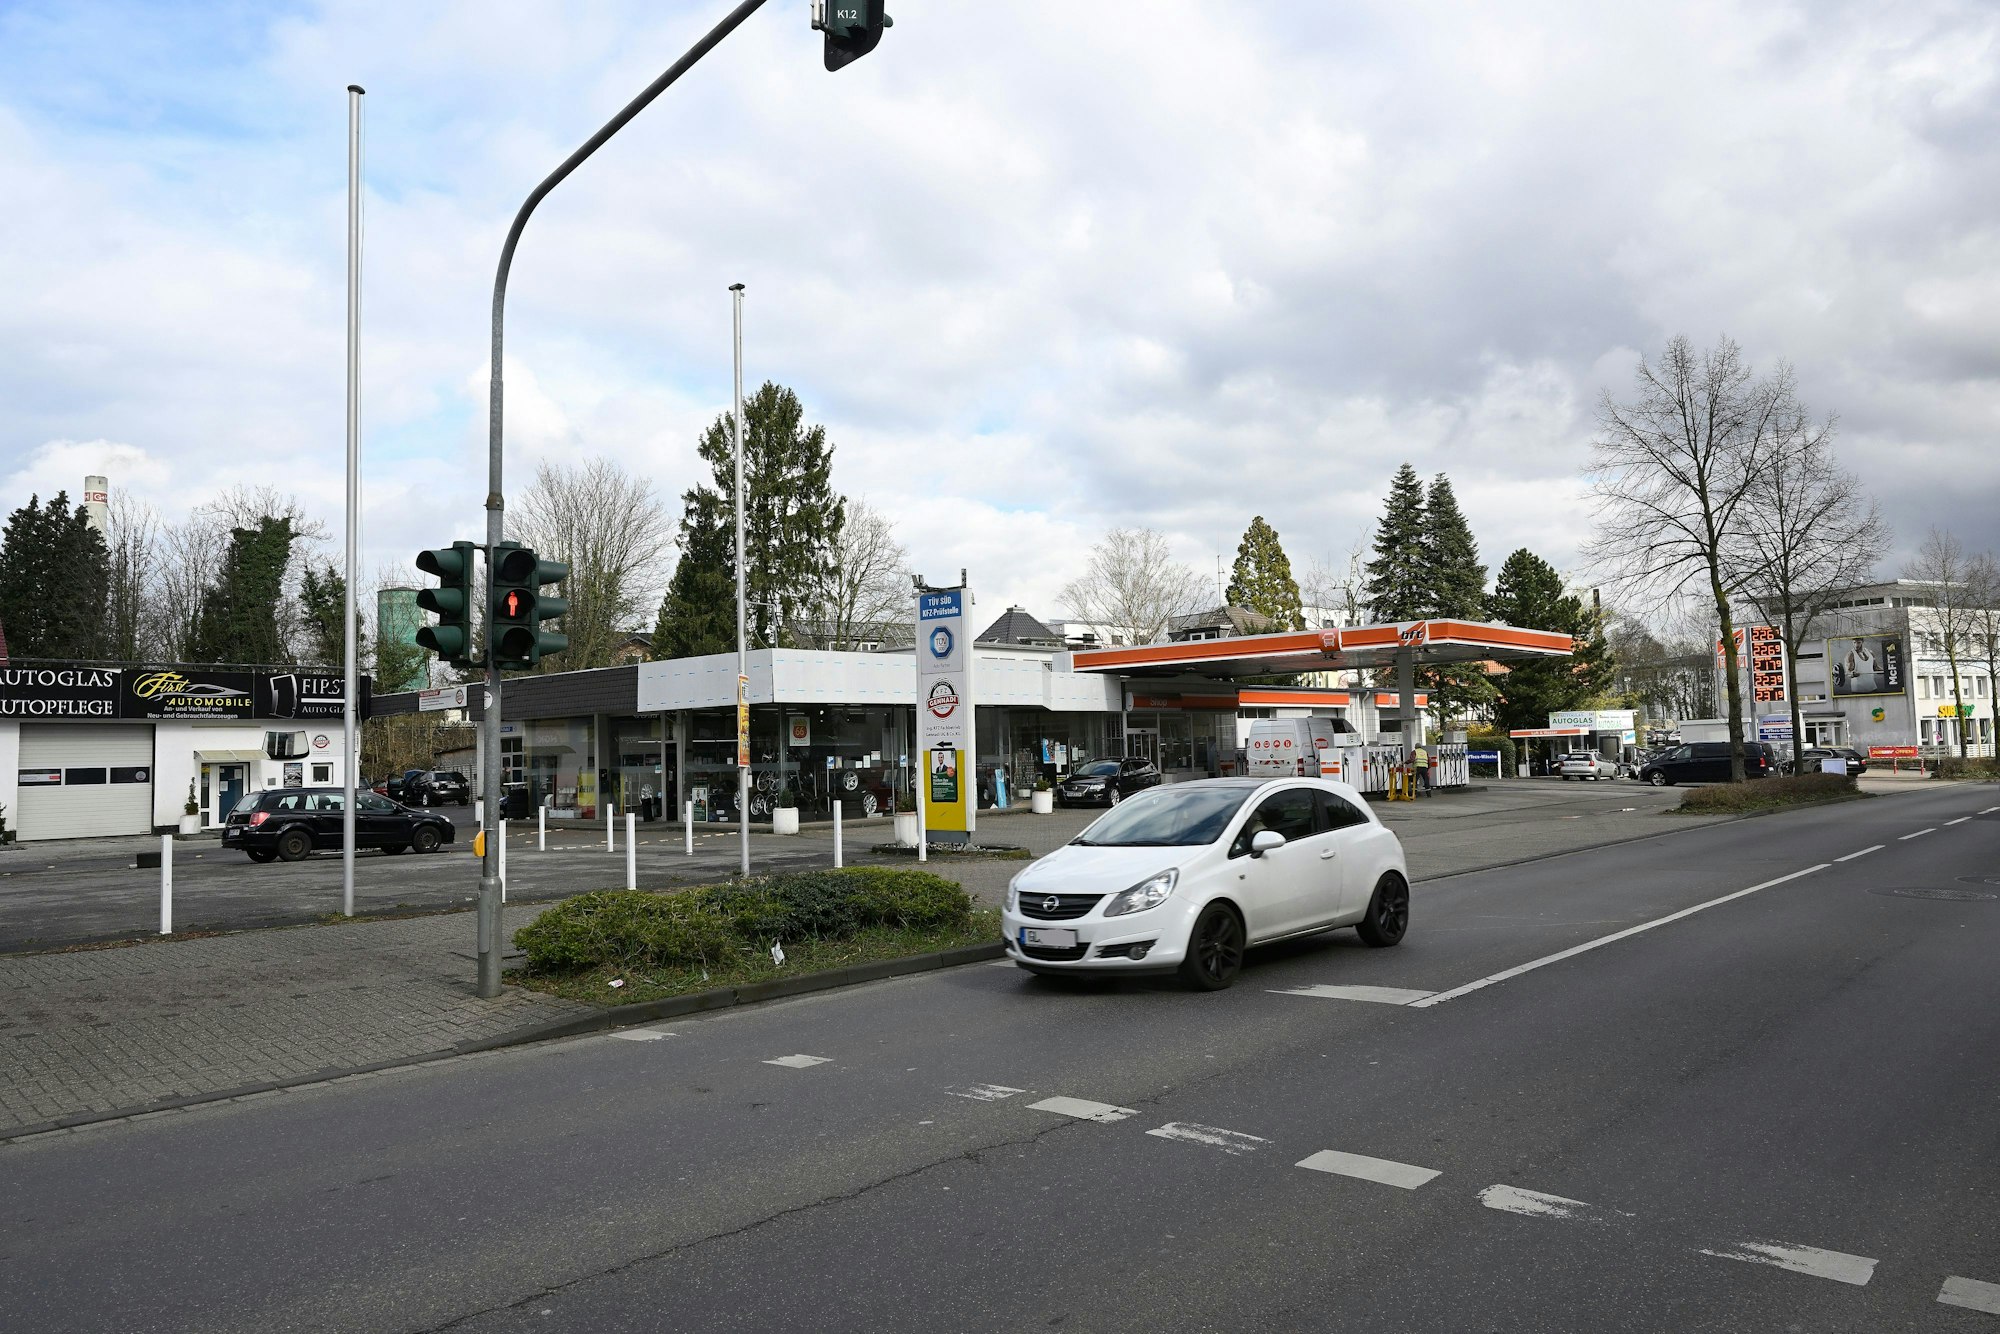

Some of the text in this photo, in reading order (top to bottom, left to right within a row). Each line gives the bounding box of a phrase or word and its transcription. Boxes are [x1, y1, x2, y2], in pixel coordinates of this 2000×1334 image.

[837, 9, 857, 19] K1.2
[928, 595, 952, 606] TÜV SÜD
[922, 606, 959, 617] KFZ-Prüfstelle
[1401, 629, 1423, 640] bft
[133, 671, 191, 698] First
[0, 699, 113, 715] UTOPFLEGE
[929, 696, 957, 707] GENNADI
[1150, 697, 1168, 707] Shop
[1552, 717, 1593, 725] AUTOGLAS
